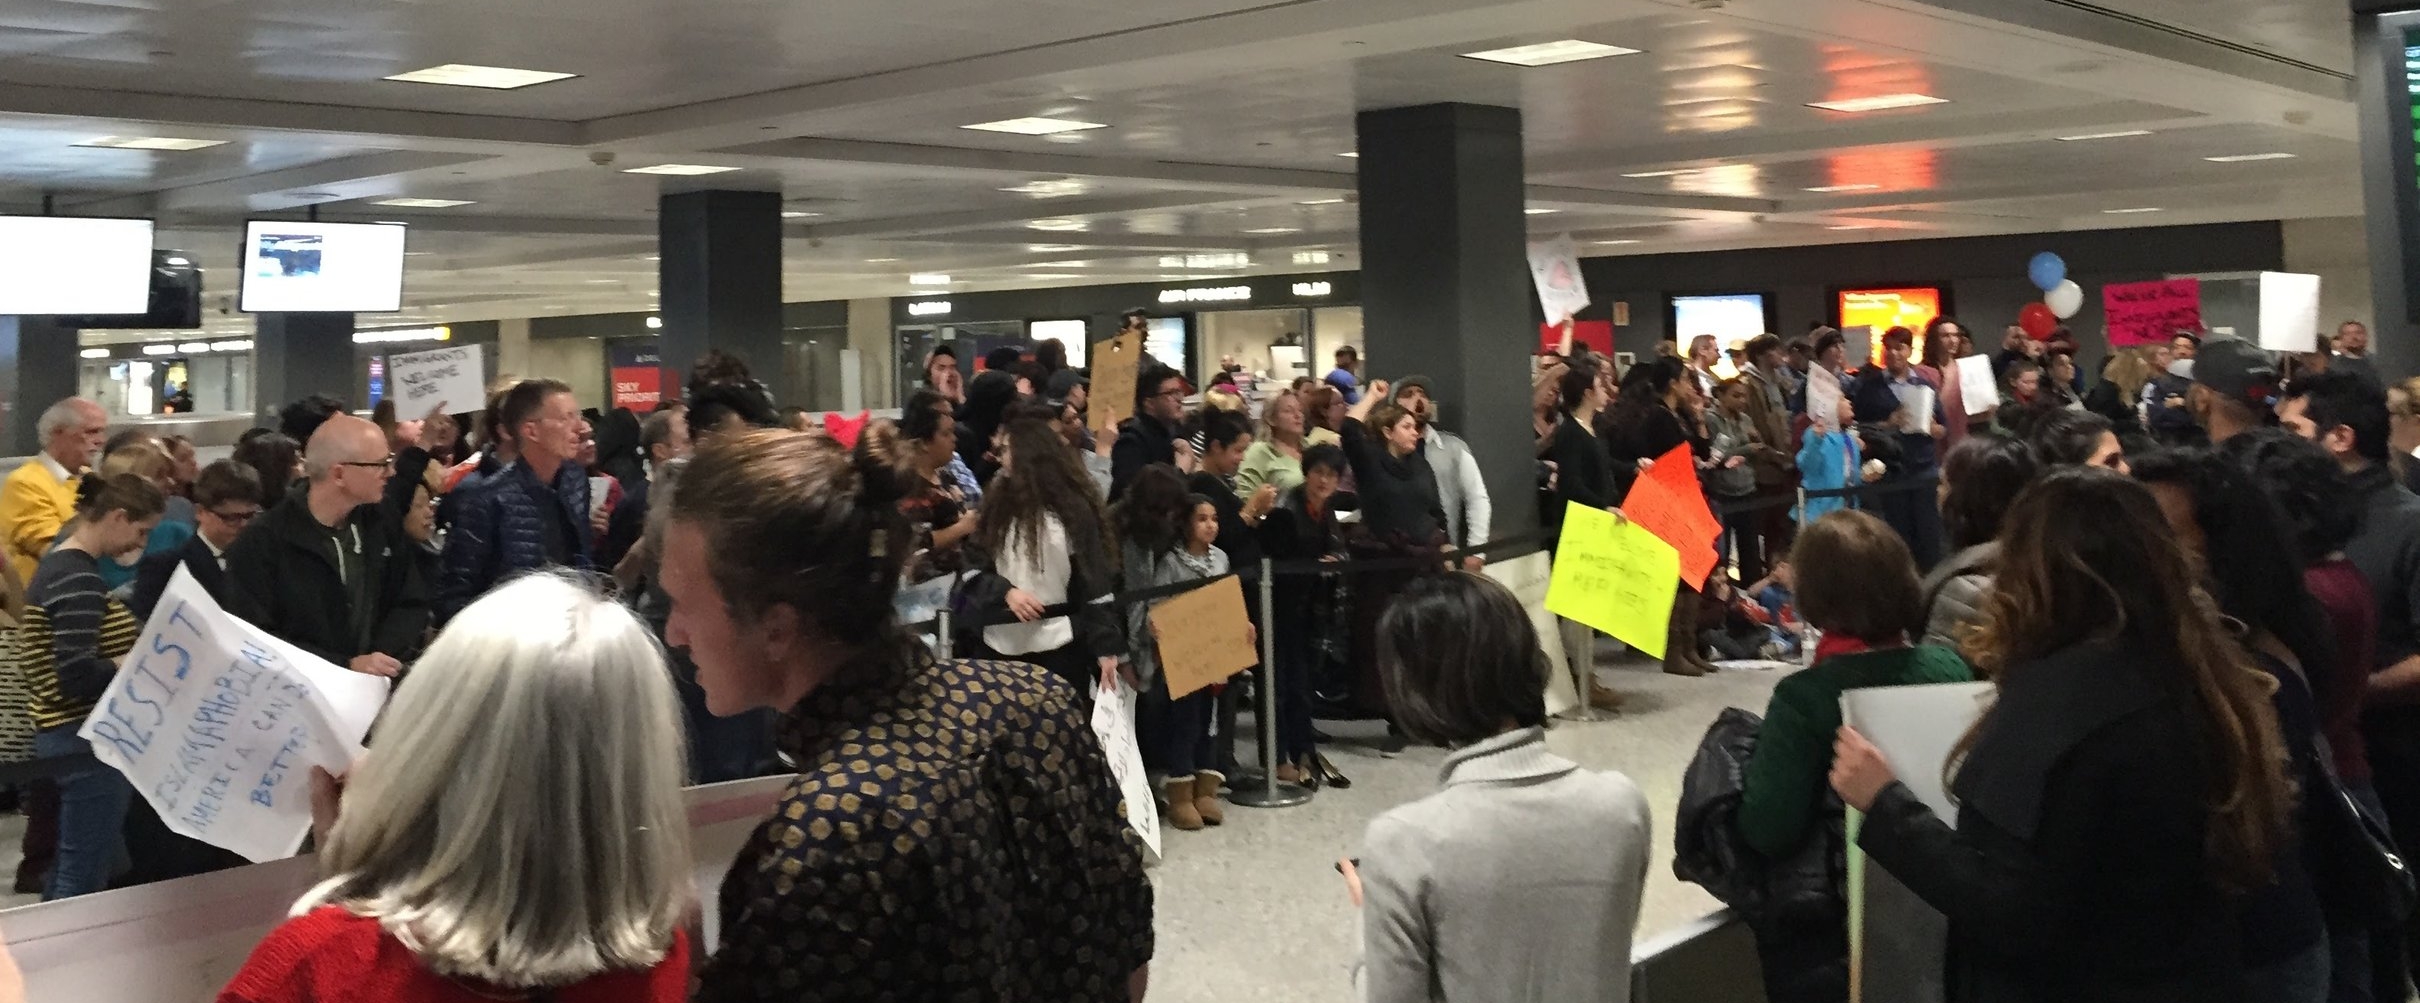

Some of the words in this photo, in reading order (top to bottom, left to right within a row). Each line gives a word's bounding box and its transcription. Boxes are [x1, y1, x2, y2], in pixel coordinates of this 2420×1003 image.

[616, 382, 640, 393] SKY
[616, 392, 661, 403] PRIORIT
[92, 600, 203, 765] RESIST
[181, 746, 255, 832] AMERICA
[251, 700, 292, 731] CAN
